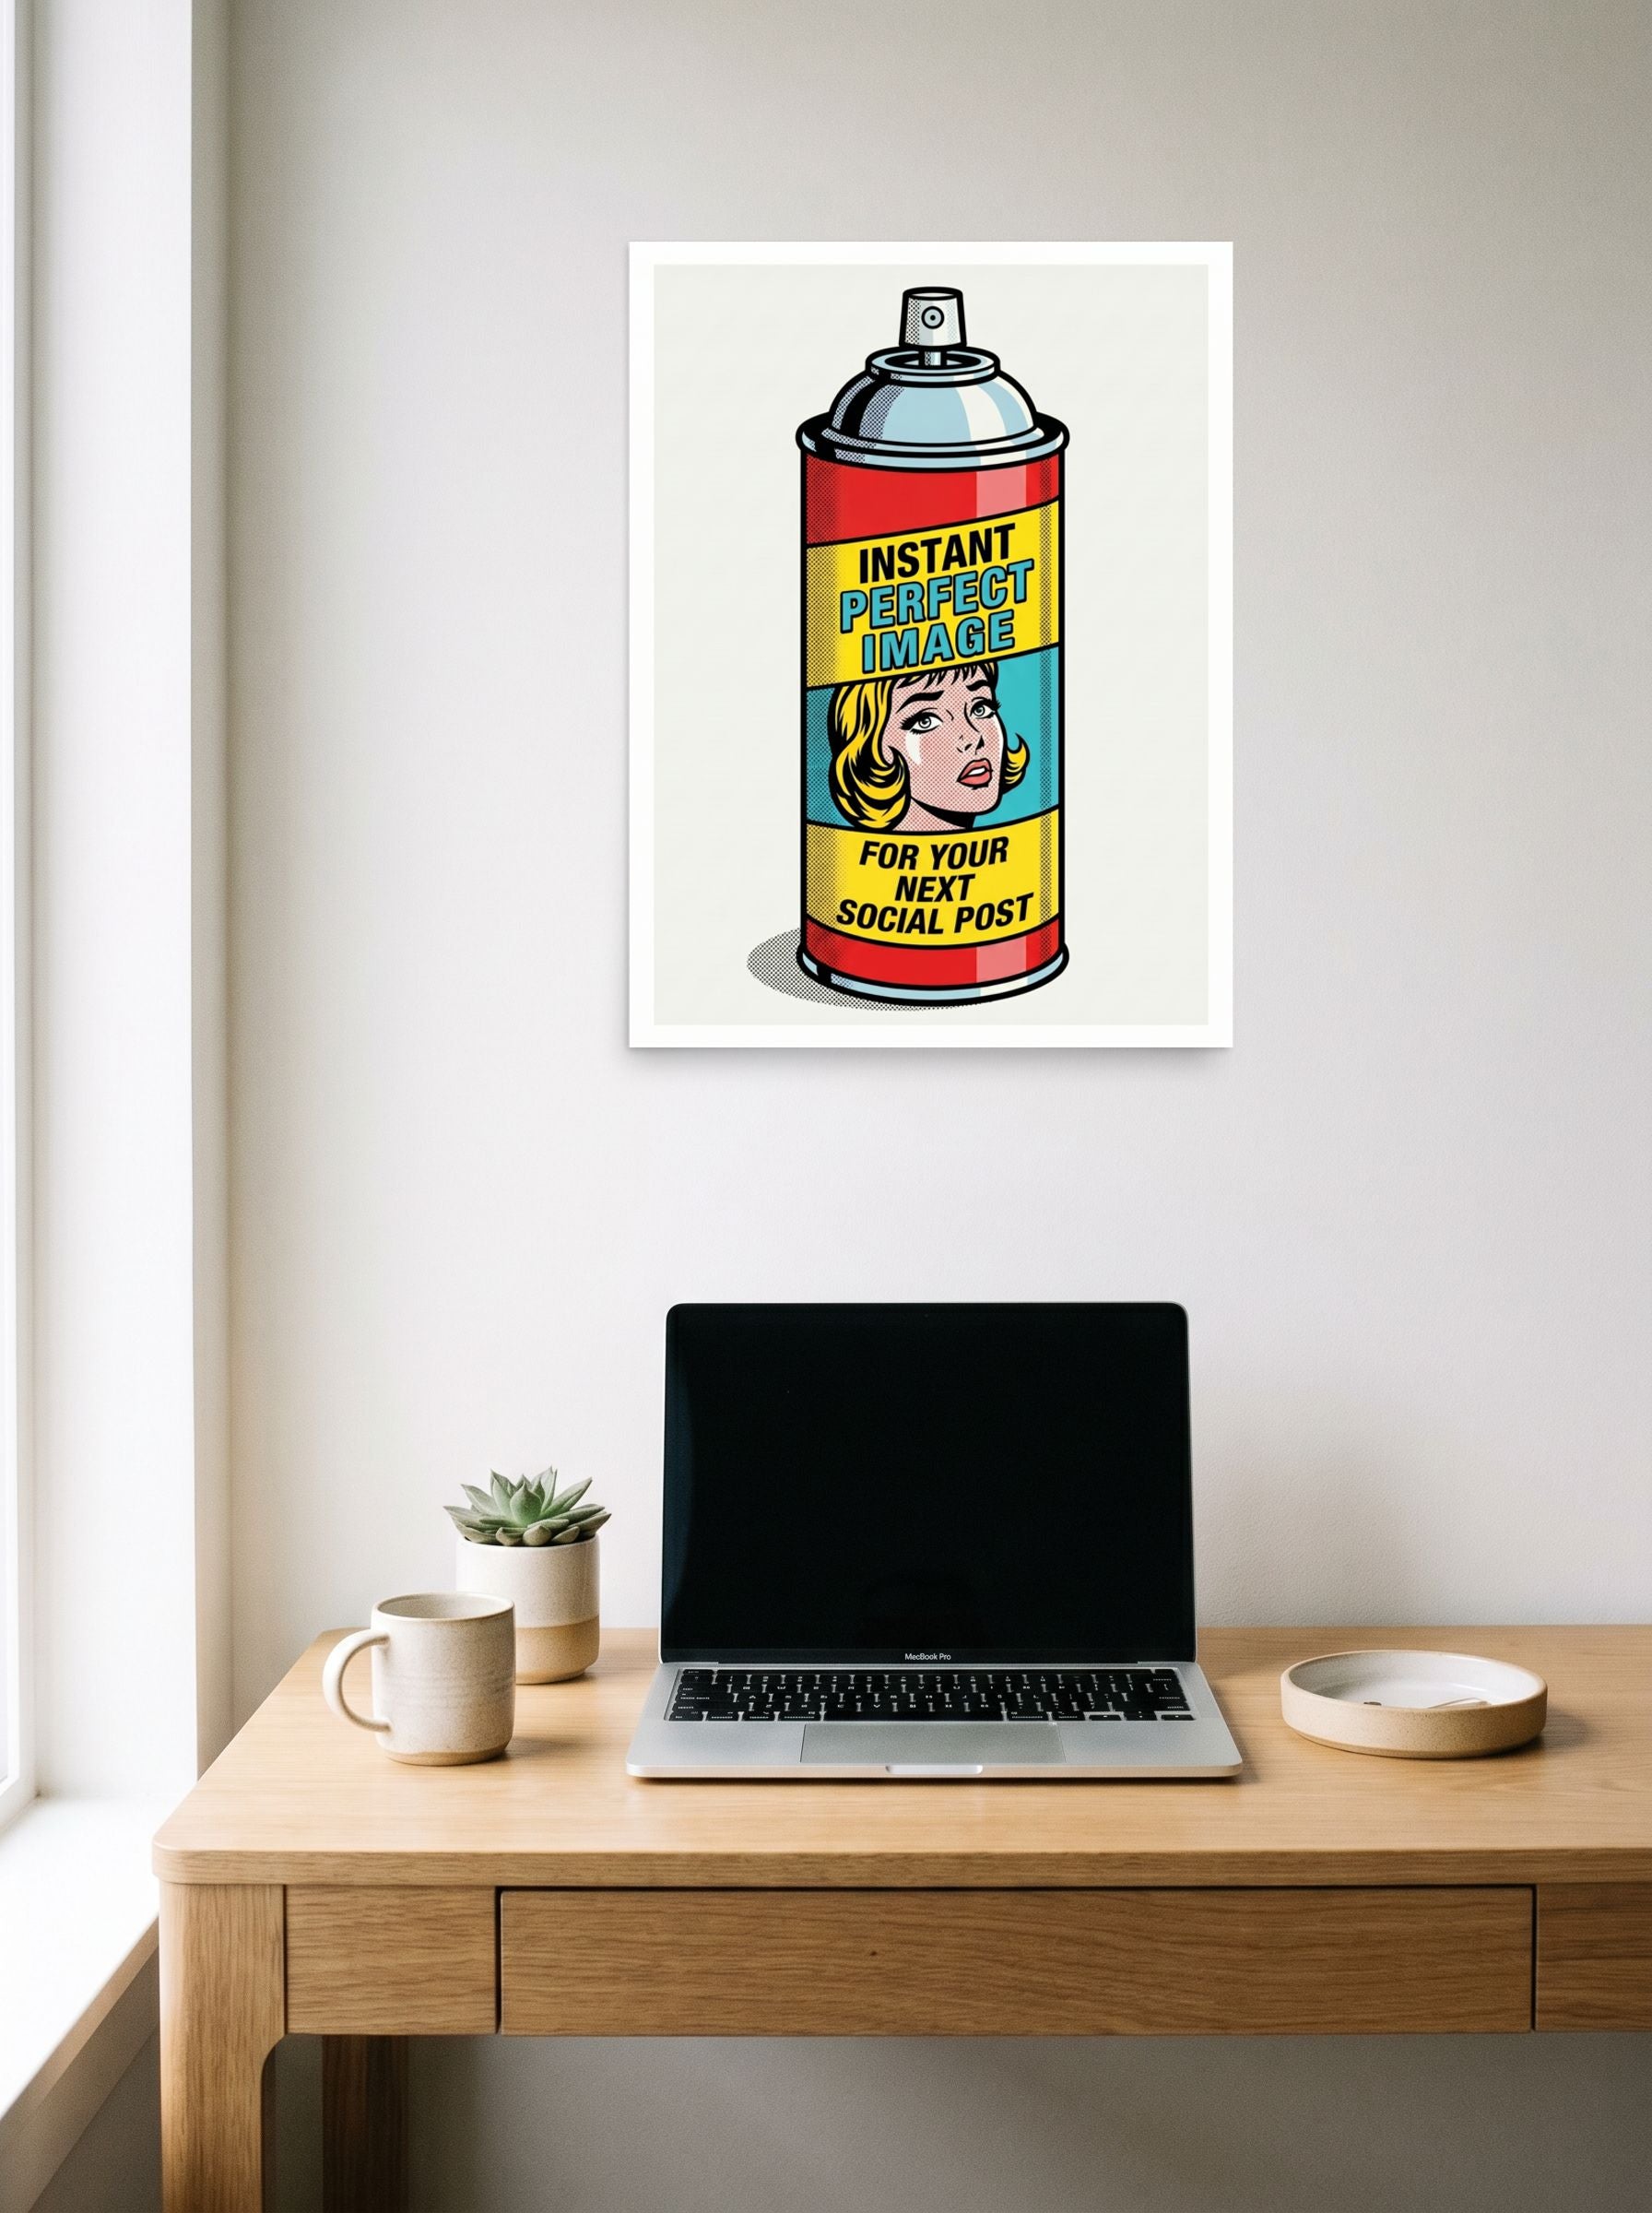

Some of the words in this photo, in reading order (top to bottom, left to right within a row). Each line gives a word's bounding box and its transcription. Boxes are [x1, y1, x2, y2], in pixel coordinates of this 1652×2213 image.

[859, 522, 1016, 584] INSTANT
[840, 558, 1035, 634] PERFECT
[862, 609, 1015, 674] IMAGE
[859, 840, 919, 870] FOR
[930, 835, 1009, 870] YOUR
[894, 873, 975, 903] NEXT
[835, 899, 945, 935] SOCIAL
[953, 892, 1034, 933] POST
[938, 1652, 951, 1661] Pro
